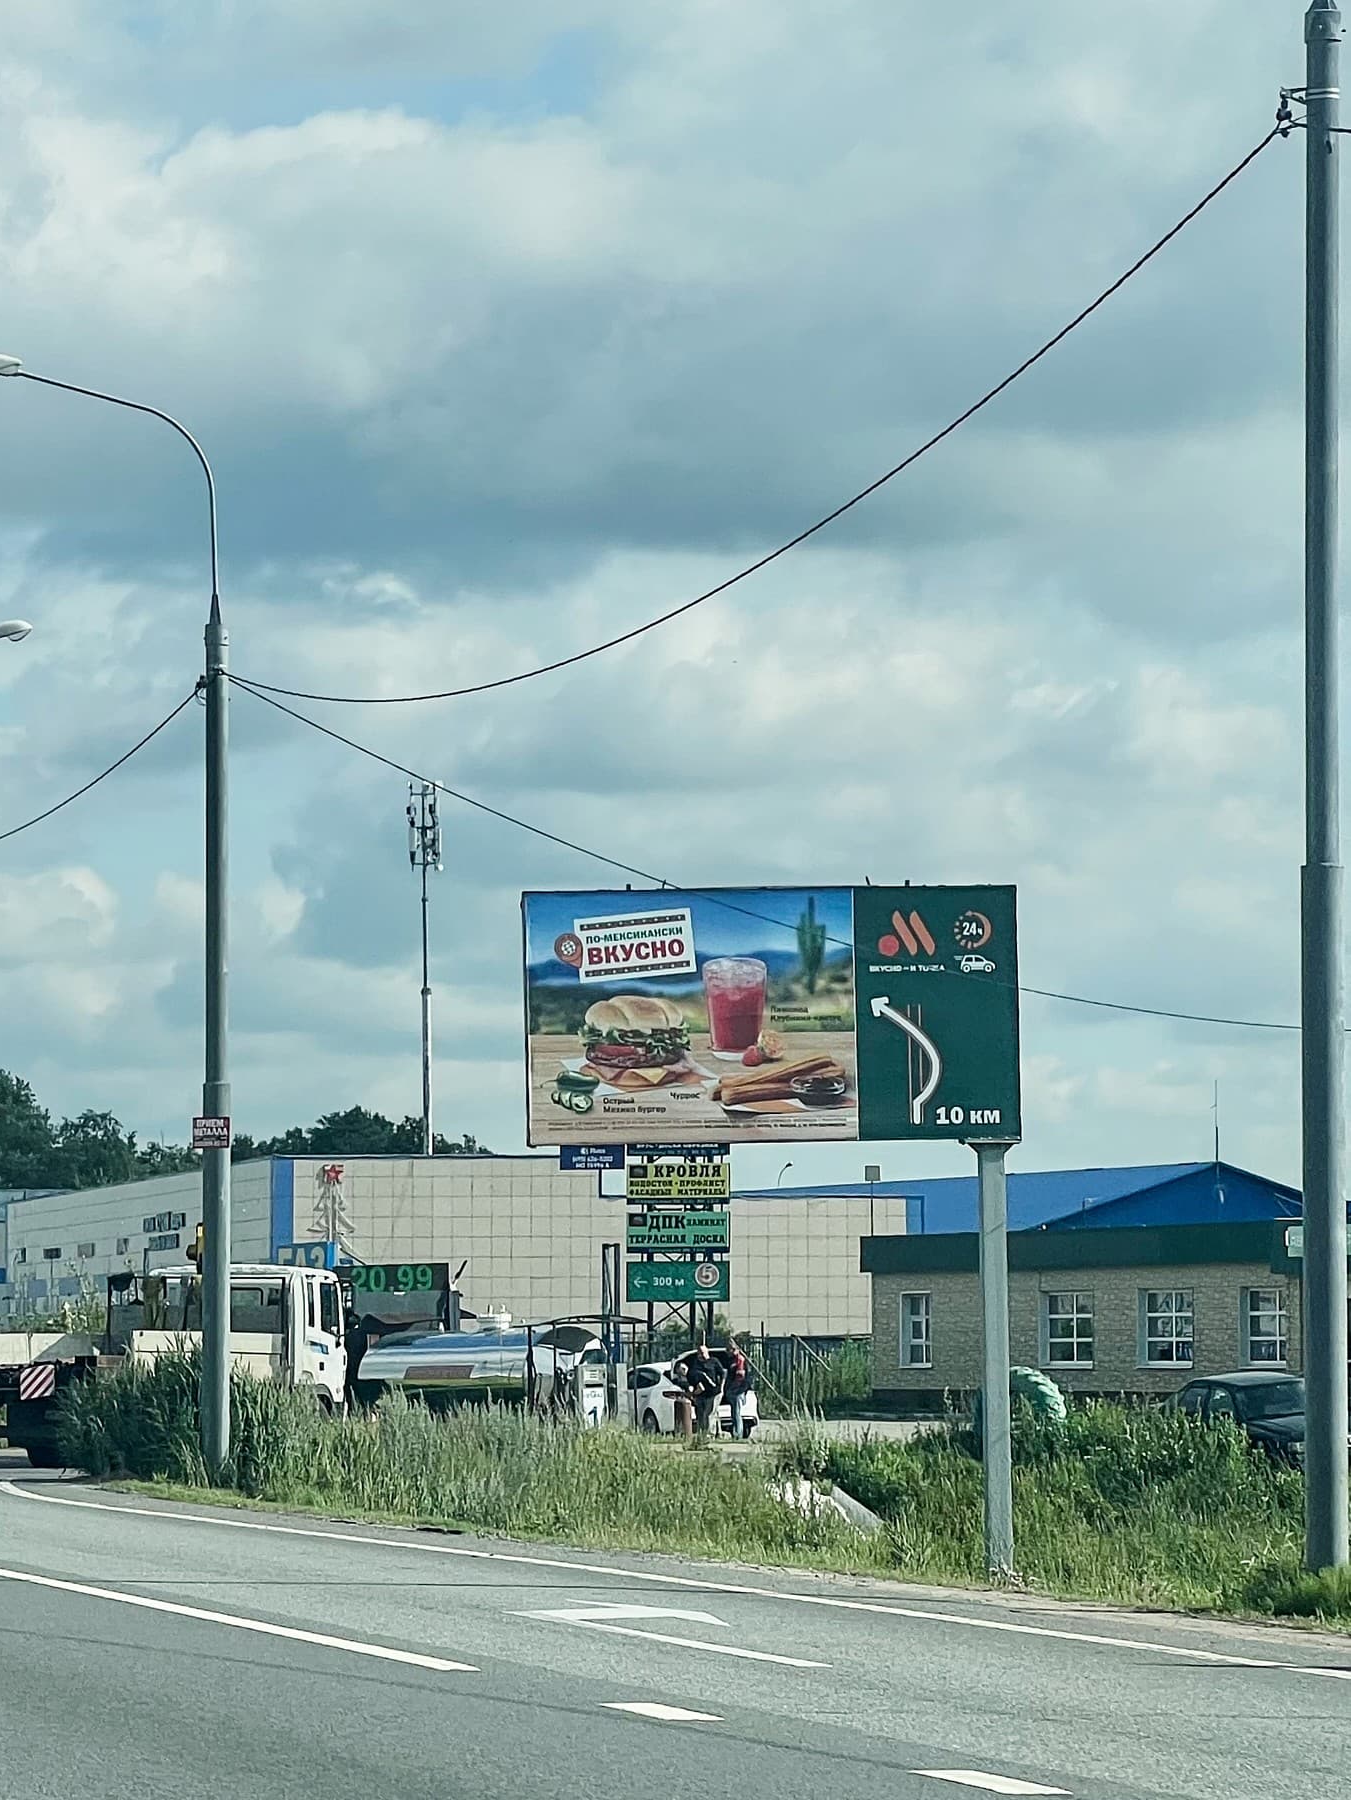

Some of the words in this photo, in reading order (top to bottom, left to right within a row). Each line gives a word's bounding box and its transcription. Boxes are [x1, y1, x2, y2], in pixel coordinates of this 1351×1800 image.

[585, 926, 683, 944] ПО-МЕКСИКАНСКИ
[587, 939, 685, 965] ВКУСНО
[936, 1106, 964, 1124] 10
[654, 1165, 722, 1178] КРОВЛЯ
[648, 1215, 685, 1232] ДПК
[693, 1234, 725, 1244] ДОСКА
[653, 1277, 672, 1286] 300
